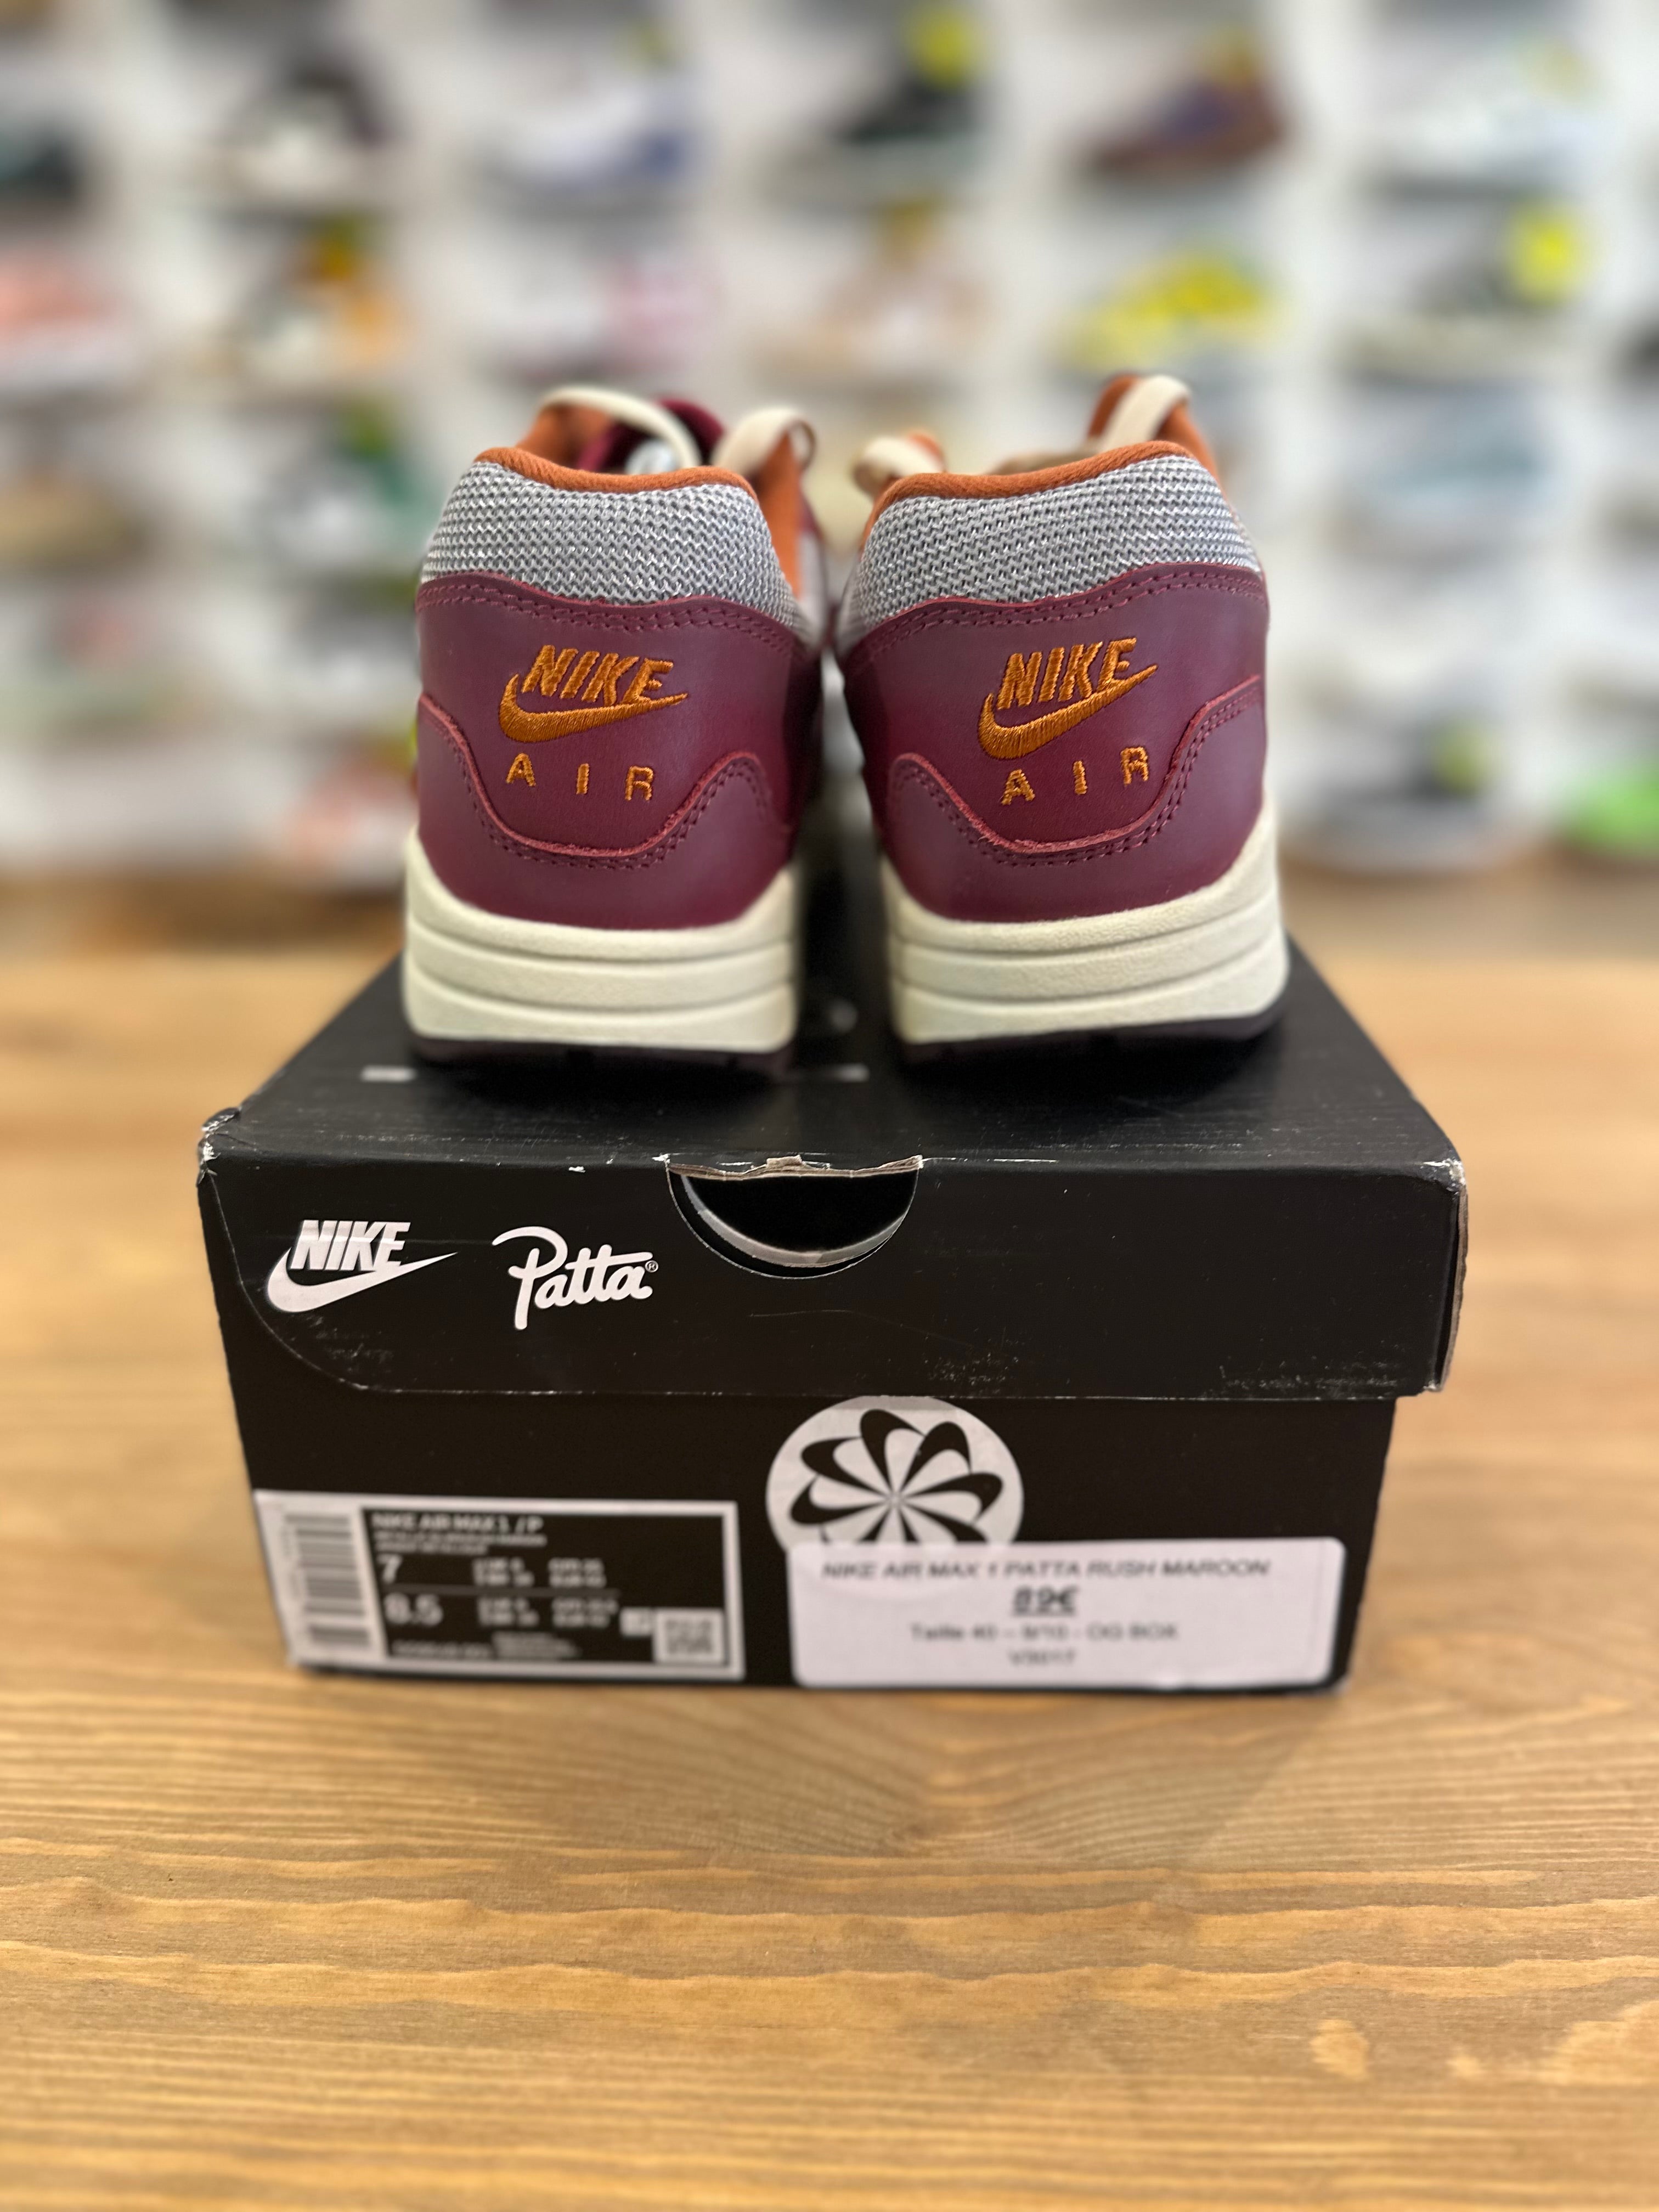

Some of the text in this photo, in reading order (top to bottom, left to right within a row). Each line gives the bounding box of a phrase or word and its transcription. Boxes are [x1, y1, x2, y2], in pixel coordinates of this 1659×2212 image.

[521, 645, 674, 706] NIKE
[996, 637, 1137, 710] NIKE
[506, 753, 654, 802] AIR
[1000, 746, 1149, 805] AIR
[290, 1220, 411, 1272] NIKE
[371, 1513, 415, 1530] NIKE
[377, 1554, 402, 1584] 7
[822, 1561, 877, 1579] NIKE
[883, 1561, 923, 1579] AIR
[929, 1561, 980, 1579] MAX
[1003, 1561, 1080, 1578] PATTA
[1087, 1560, 1157, 1578] RUSH
[1161, 1559, 1271, 1577] MAROON
